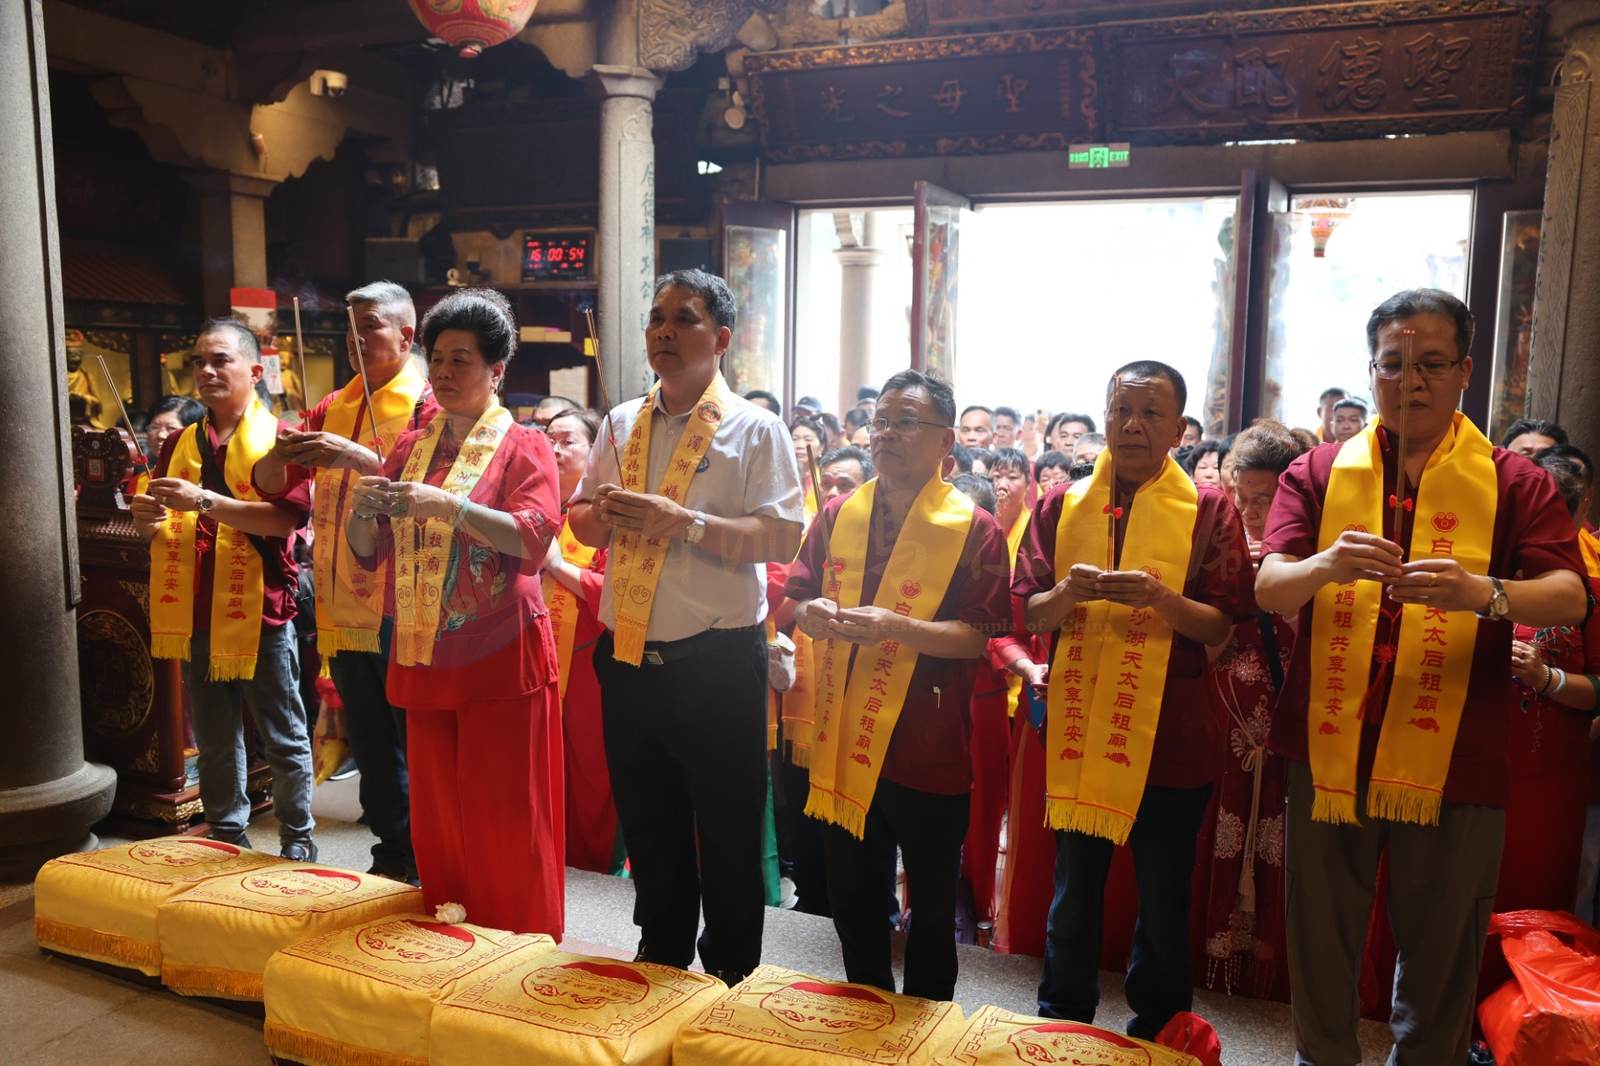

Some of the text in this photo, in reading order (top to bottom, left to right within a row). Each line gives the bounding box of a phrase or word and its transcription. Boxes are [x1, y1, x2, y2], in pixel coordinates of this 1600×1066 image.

[1109, 151, 1130, 161] EXIT
[1063, 669, 1084, 744] 共享平安
[1324, 636, 1350, 717] 共享平安
